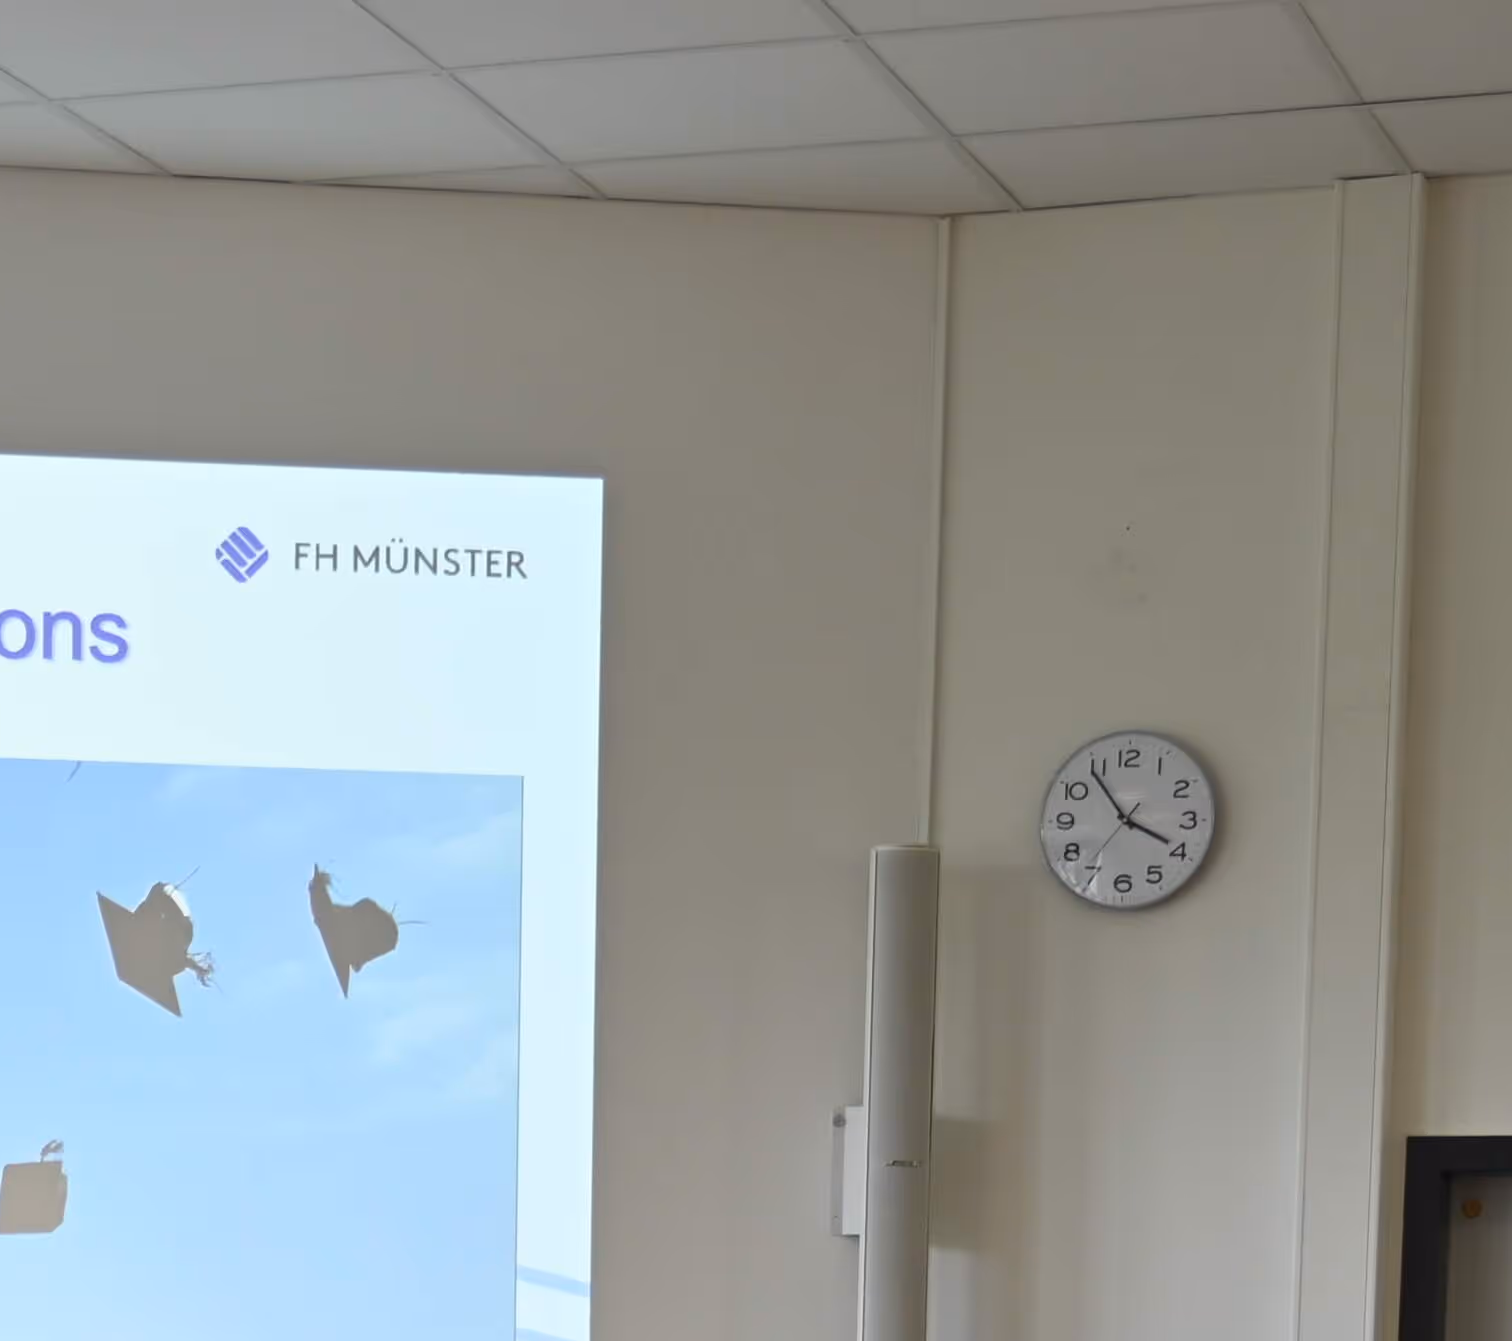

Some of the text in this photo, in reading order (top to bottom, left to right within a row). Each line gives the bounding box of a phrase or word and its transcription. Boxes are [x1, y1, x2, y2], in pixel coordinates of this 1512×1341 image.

[294, 537, 528, 579] FH MÜNSTER
[1118, 749, 1141, 768] 12
[1065, 781, 1089, 801] 10
[1173, 779, 1190, 799] 2
[1056, 812, 1075, 831] 9
[1179, 811, 1197, 830] 3
[1063, 843, 1080, 862] 8
[1169, 842, 1187, 861] 4
[1113, 874, 1133, 893] 6
[1146, 865, 1163, 884] 5
